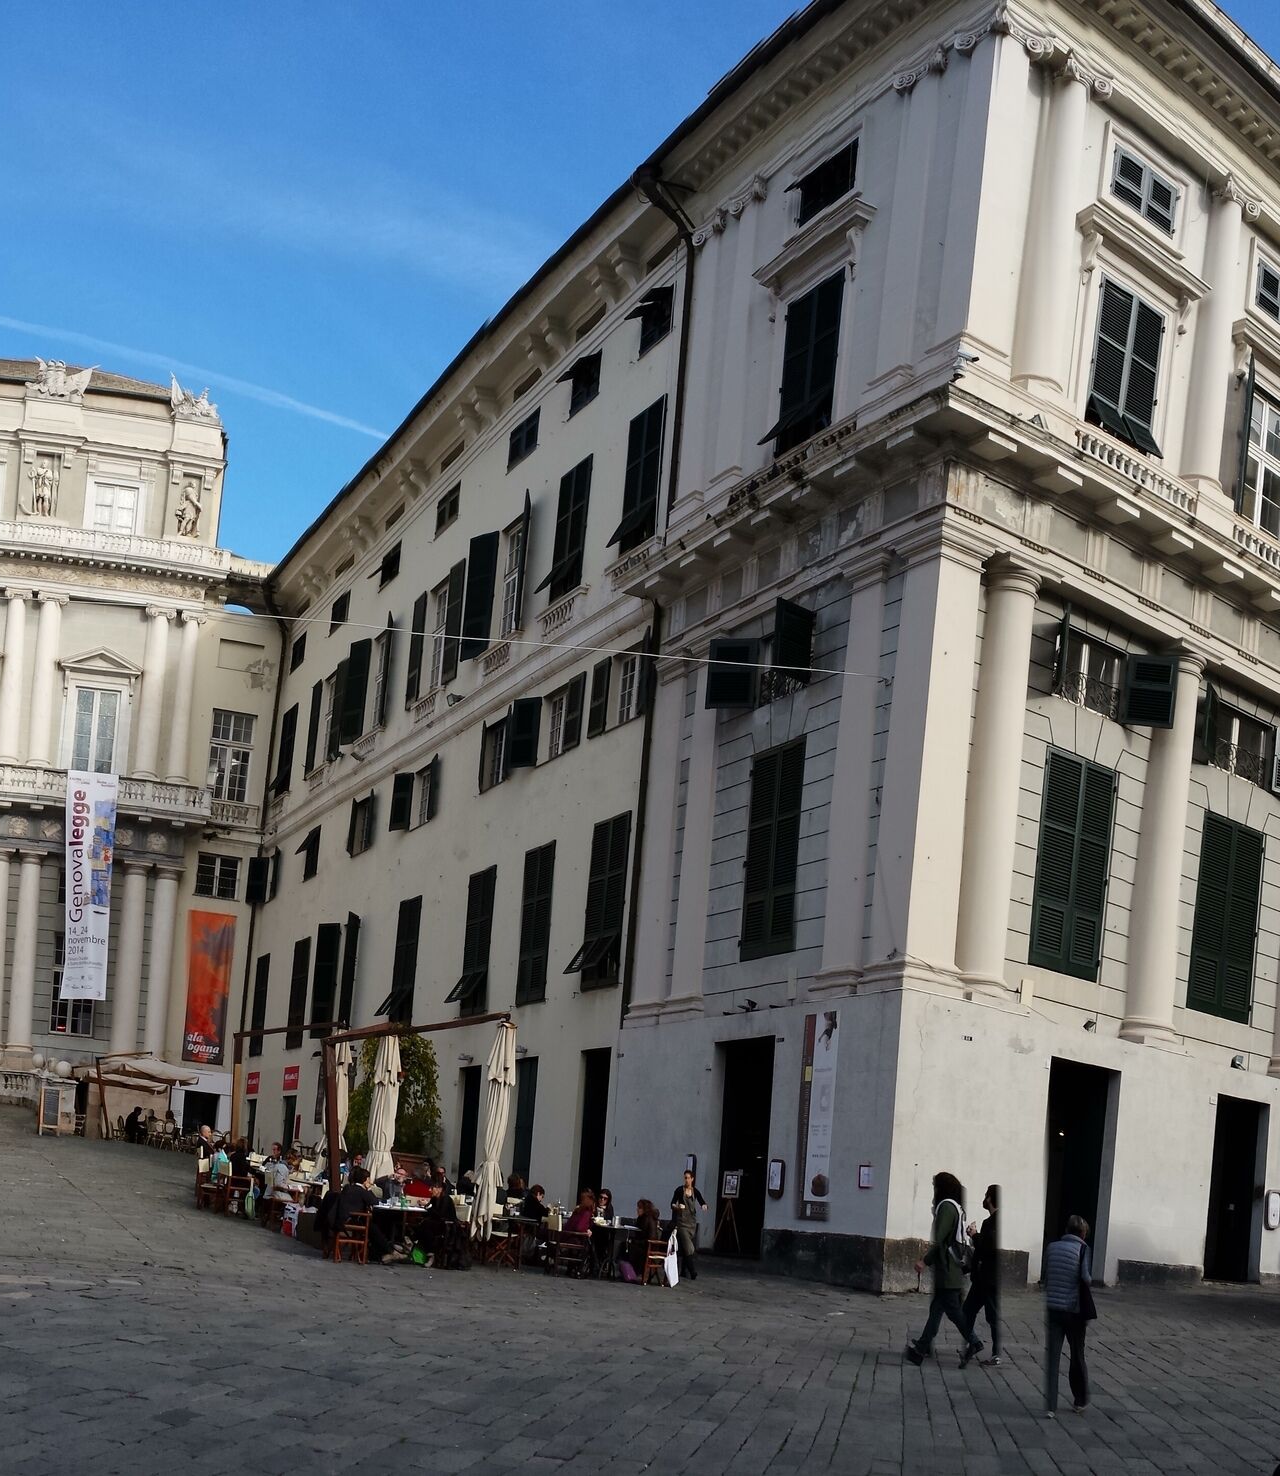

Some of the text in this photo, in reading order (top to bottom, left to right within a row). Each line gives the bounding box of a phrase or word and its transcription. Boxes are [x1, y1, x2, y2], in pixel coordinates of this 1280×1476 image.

[68, 789, 91, 923] Genovalegge
[68, 934, 106, 945] novembre
[68, 946, 84, 955] 2014
[186, 1031, 204, 1042] ala
[187, 1043, 220, 1054] ogana
